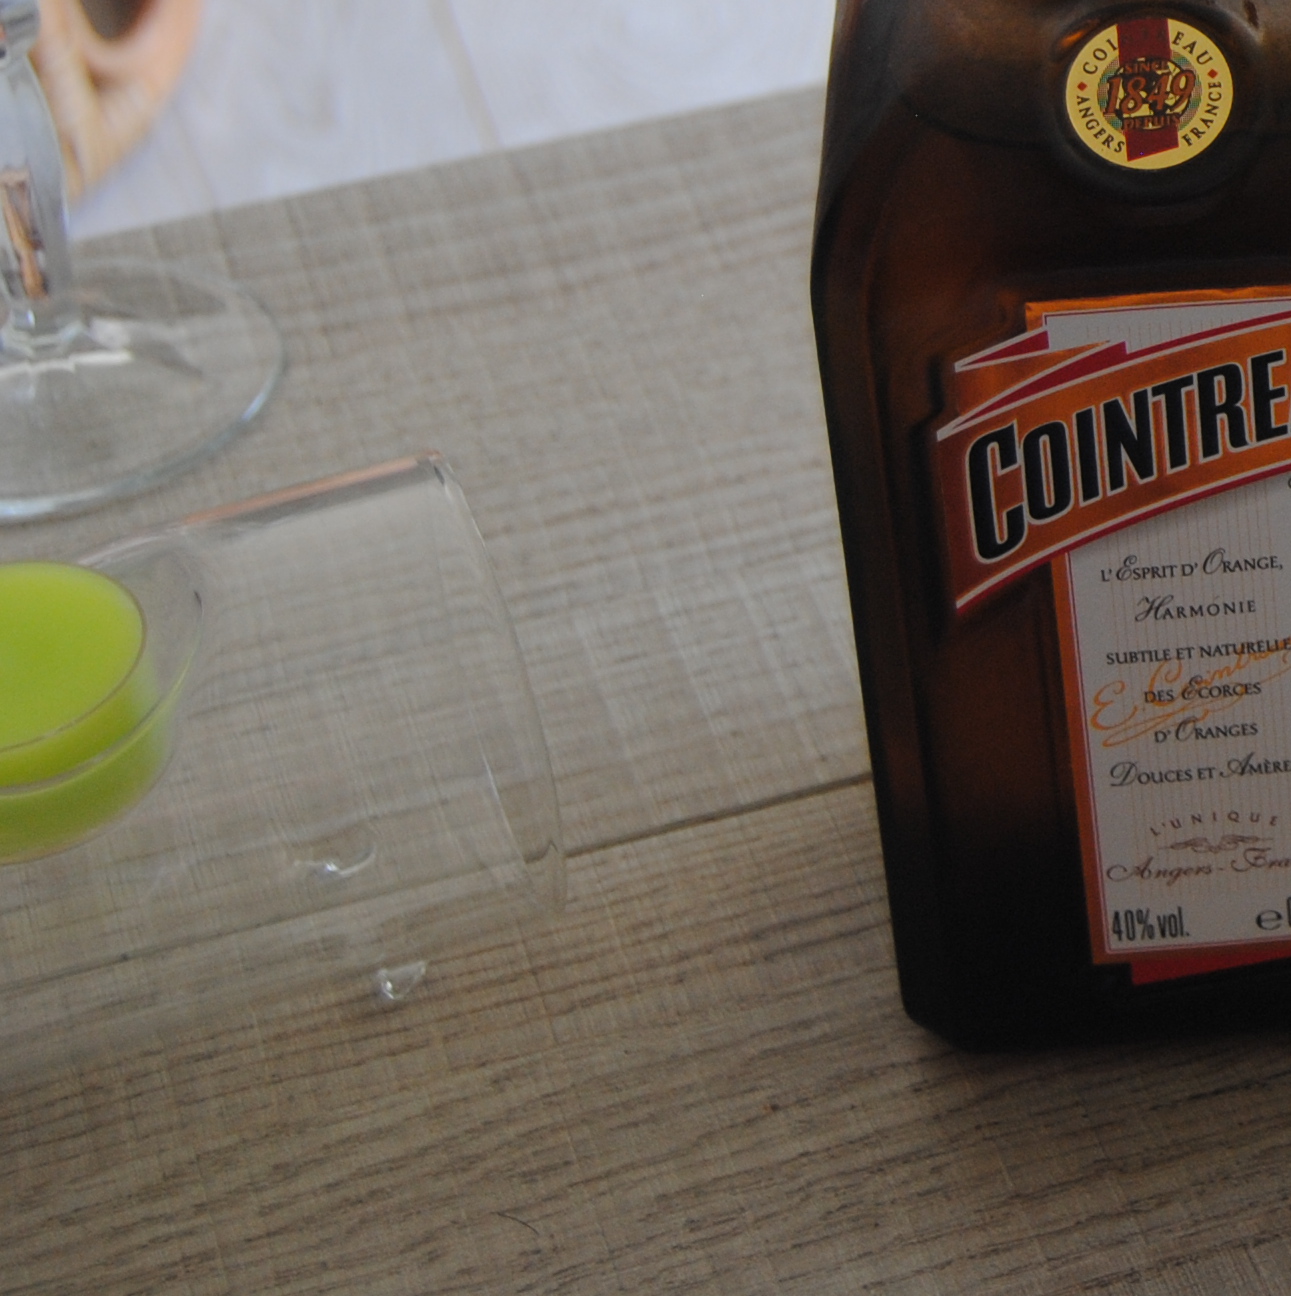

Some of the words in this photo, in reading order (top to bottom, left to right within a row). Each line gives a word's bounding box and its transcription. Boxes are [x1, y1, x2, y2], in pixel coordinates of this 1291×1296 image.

[1103, 69, 1196, 116] 1849
[1076, 95, 1125, 153] ANGERS
[1182, 81, 1222, 147] FRANCE
[1135, 595, 1257, 623] HARMONIE
[1107, 646, 1172, 666] SUBTILE
[1176, 644, 1195, 662] ET
[1144, 688, 1175, 705] DES
[1110, 761, 1194, 788] DOUCES
[1197, 766, 1216, 781] ET
[1149, 810, 1280, 838] L'UNIQUE
[1112, 908, 1155, 942] 40%
[1157, 906, 1191, 939] vol.
